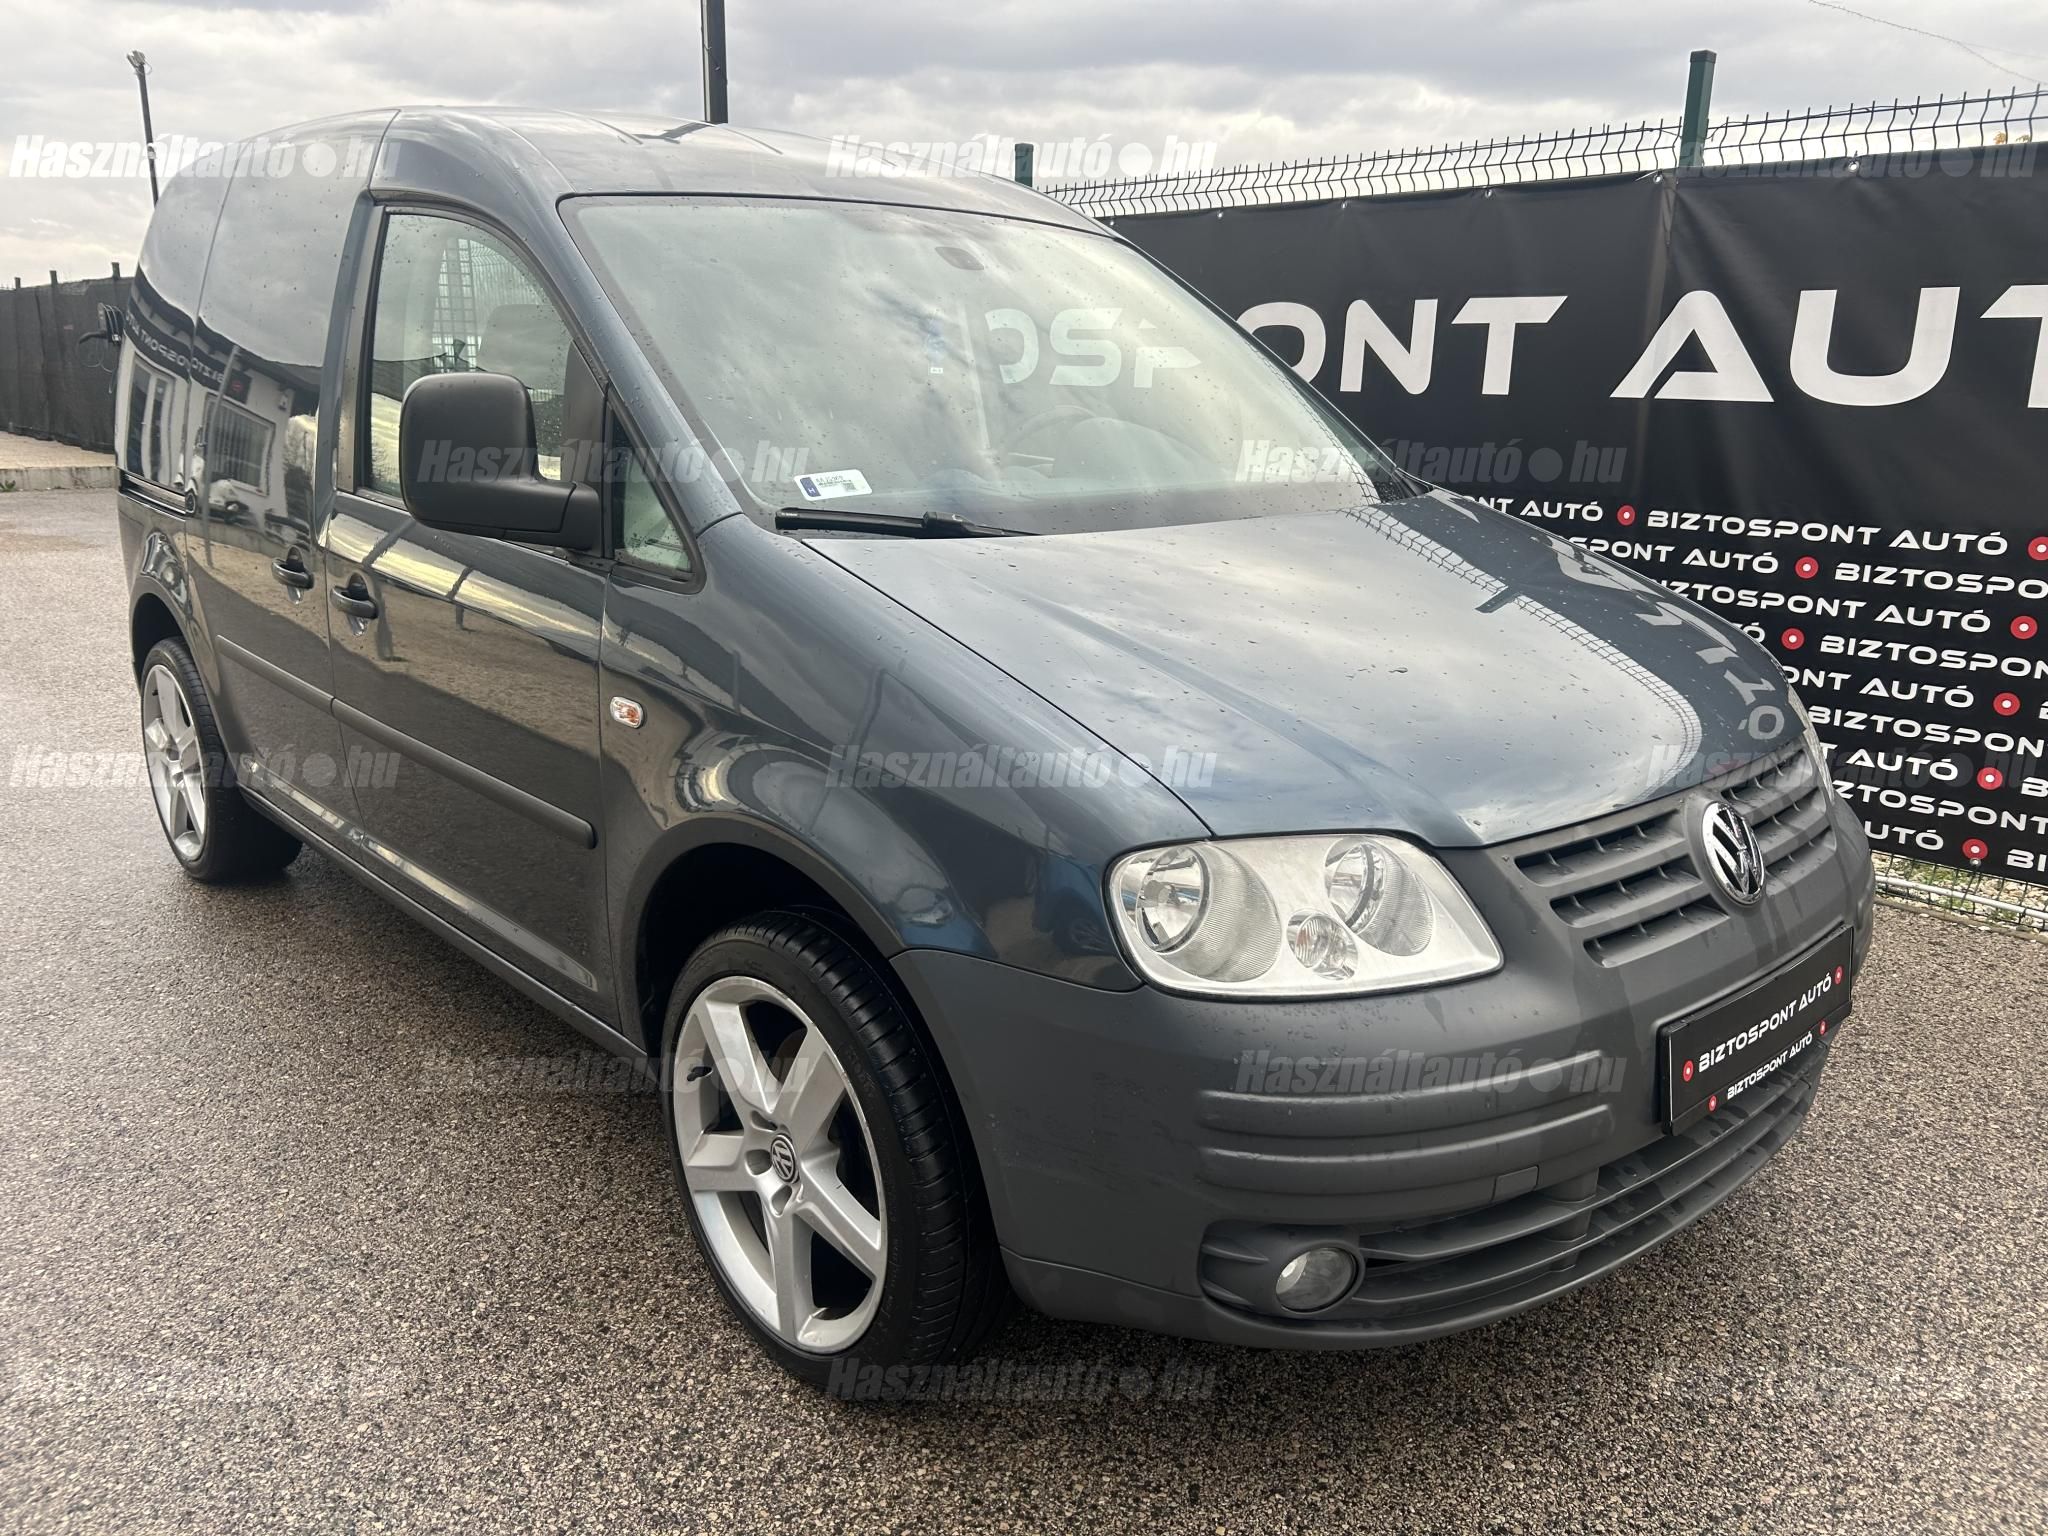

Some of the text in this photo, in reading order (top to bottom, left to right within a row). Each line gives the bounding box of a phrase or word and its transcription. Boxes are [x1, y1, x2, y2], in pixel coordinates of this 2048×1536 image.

[1519, 500, 1604, 522] AUTÓ
[1647, 510, 1881, 546] BIZTOSPONT
[1888, 530, 2008, 556] AUTÓ
[1681, 551, 1779, 575] AUTÓ
[1651, 579, 1991, 633] ZTOSPONT AUTÓ
[1858, 684, 1975, 708] AUTÓ
[1845, 748, 1959, 781] AUTÓ
[1698, 973, 1832, 1073] BIZTOSPONT AUTÓ
[1727, 1031, 1813, 1100] BIZTOSPONT AUTÓ
